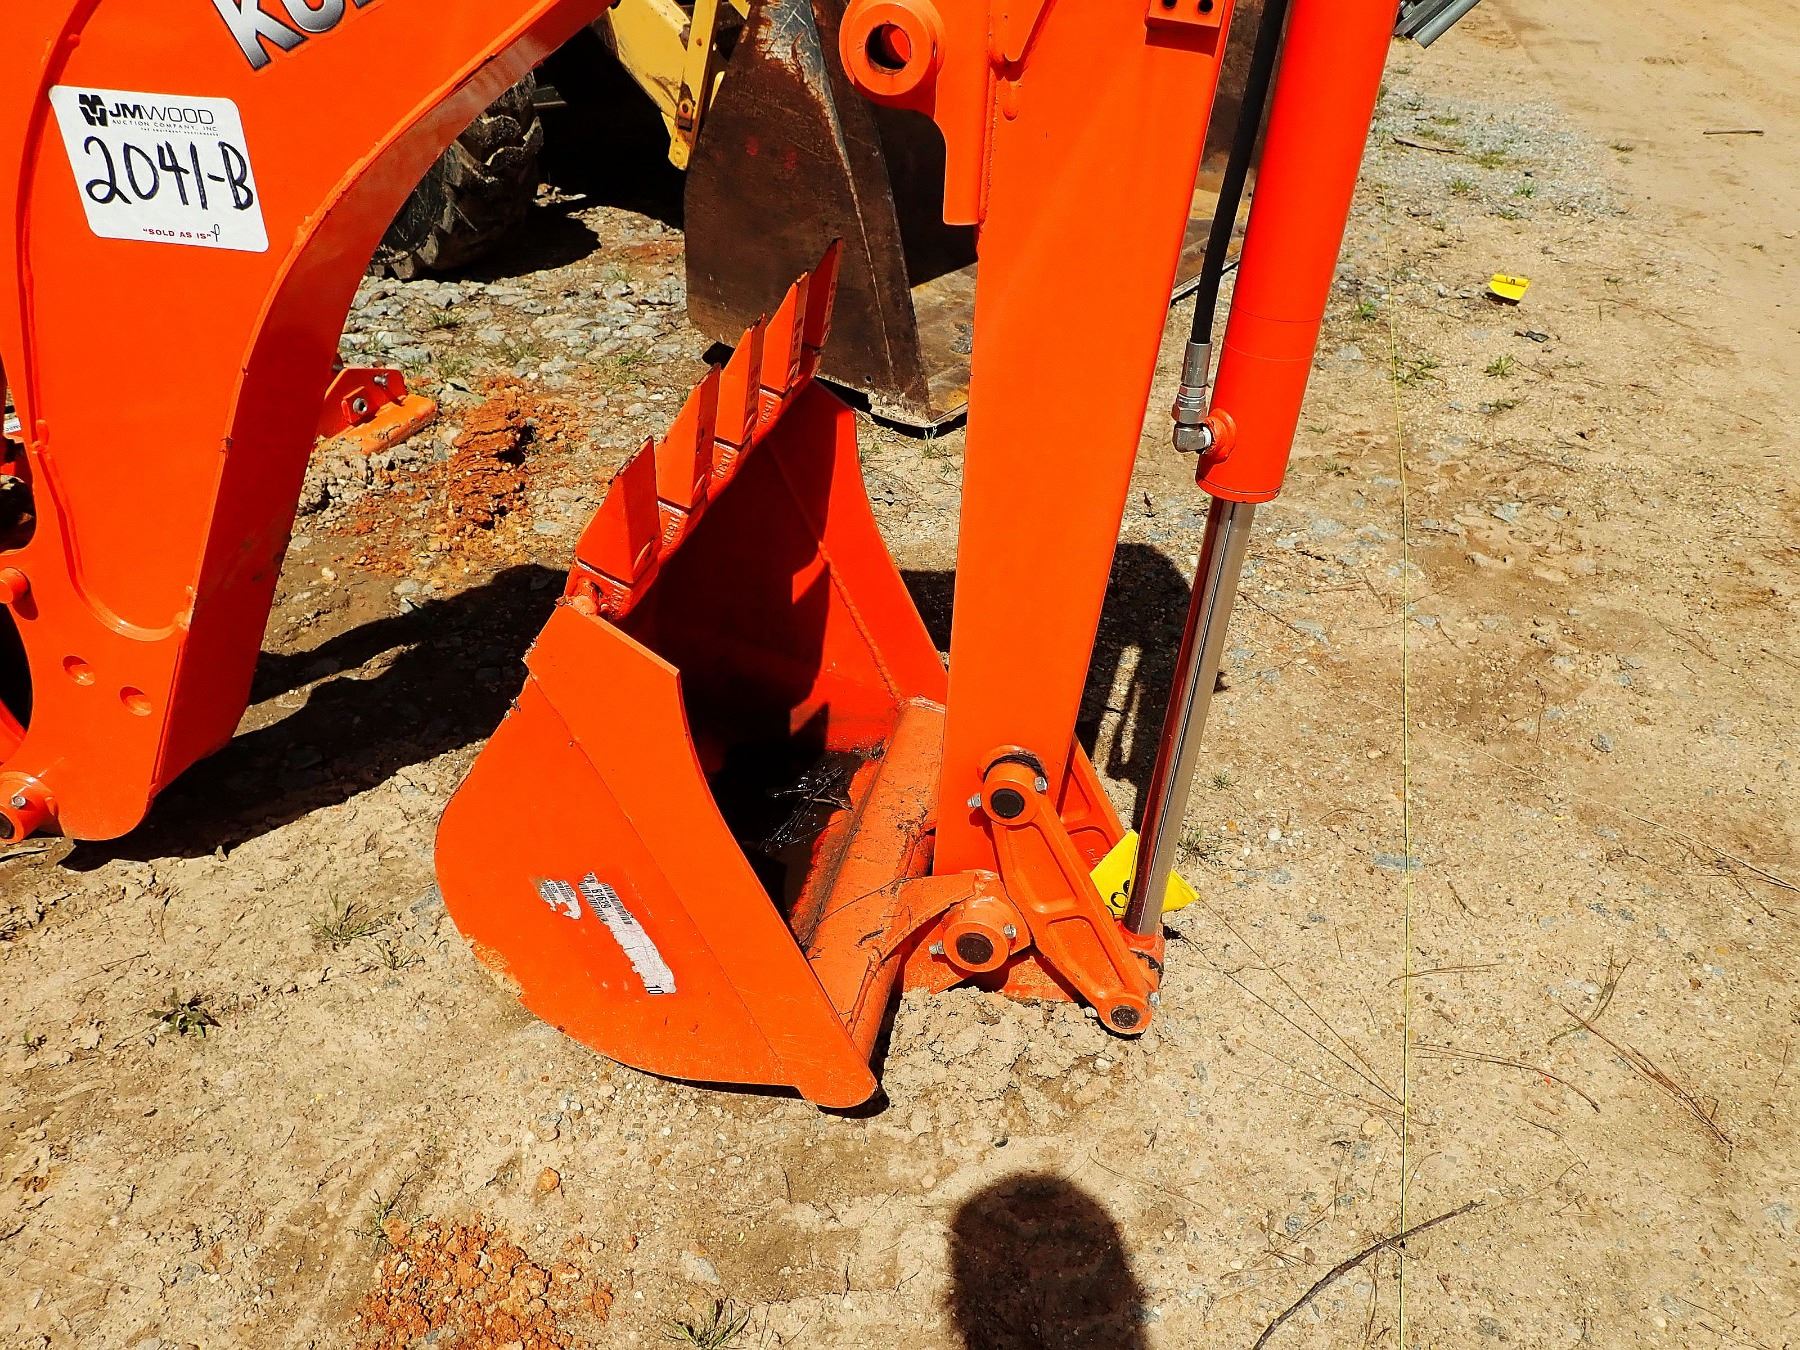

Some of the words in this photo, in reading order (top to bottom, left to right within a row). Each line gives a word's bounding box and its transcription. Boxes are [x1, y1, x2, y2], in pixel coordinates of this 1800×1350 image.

[112, 119, 150, 127] AUCTION
[84, 135, 254, 211] 2041-B
[179, 231, 193, 239] AS
